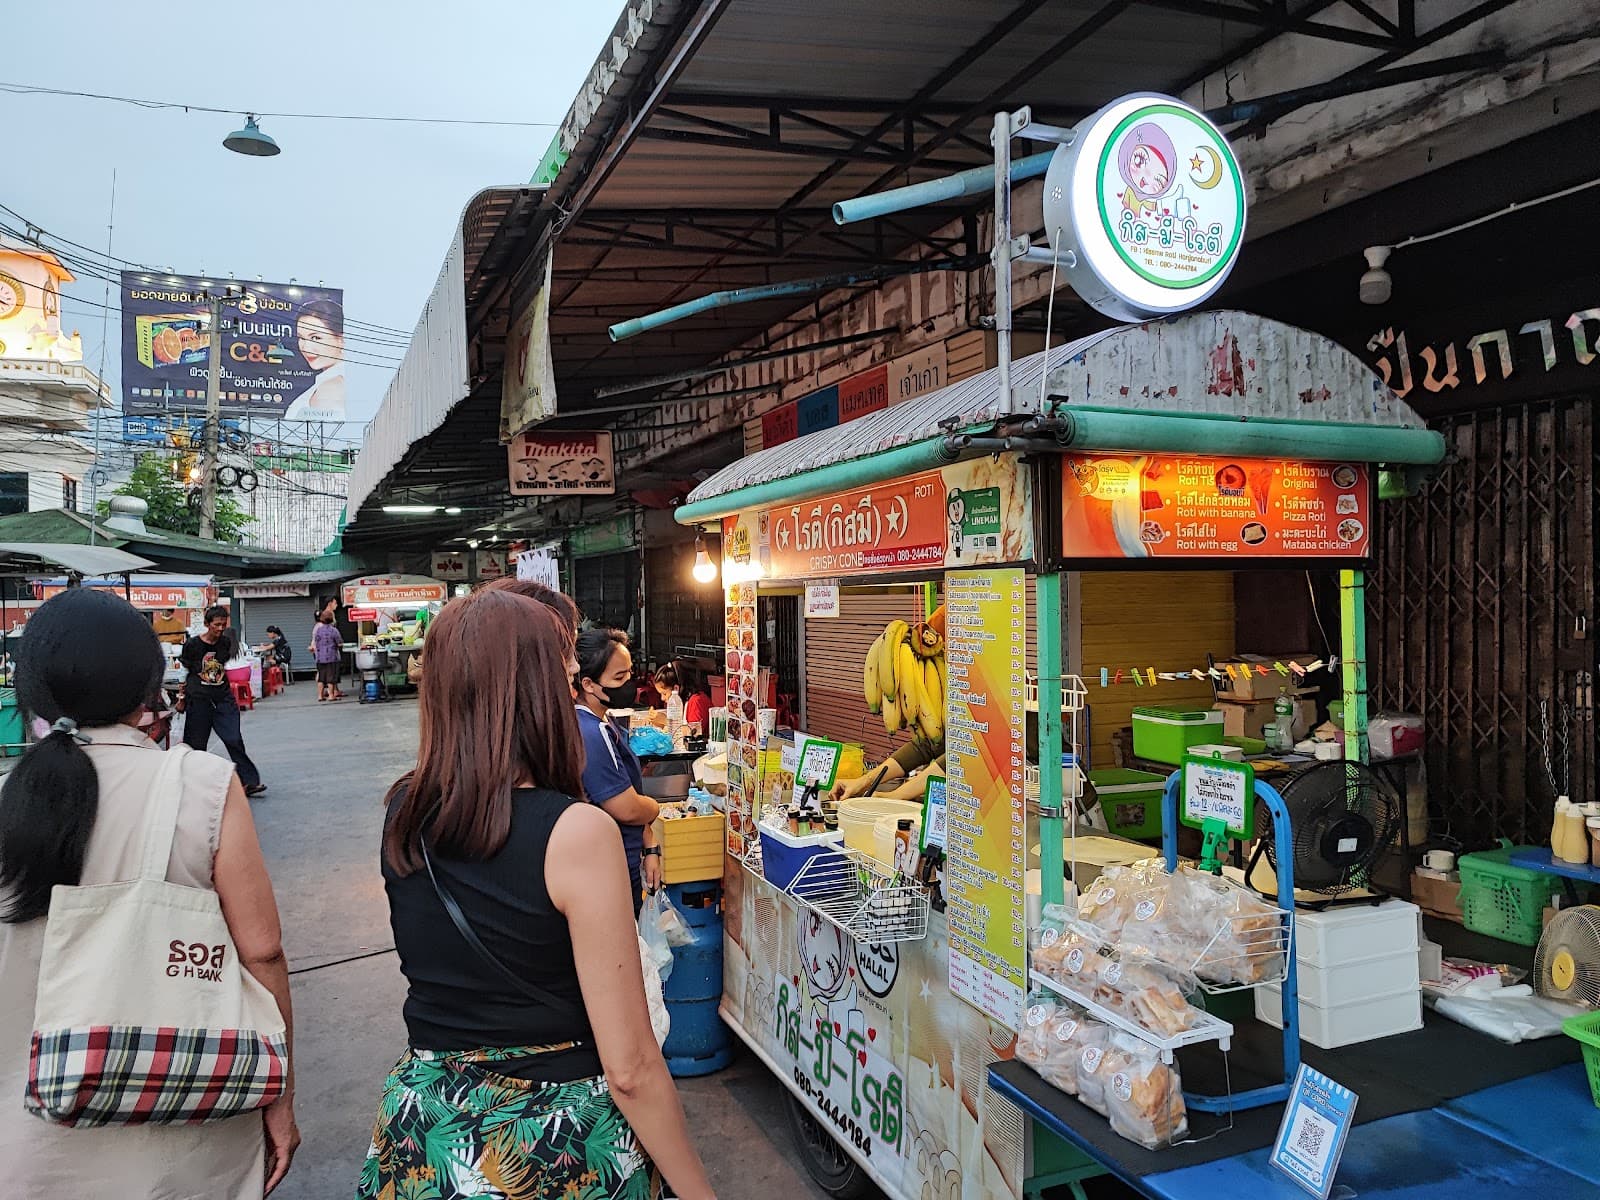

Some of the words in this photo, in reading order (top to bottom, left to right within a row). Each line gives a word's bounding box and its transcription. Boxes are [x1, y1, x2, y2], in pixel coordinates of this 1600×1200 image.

[900, 356, 940, 399] เจ้าเก่า
[1179, 475, 1198, 486] Roti
[1283, 478, 1318, 491] Original
[915, 483, 934, 499] ROTI
[1176, 507, 1196, 517] Roti
[1198, 508, 1219, 518] with
[1221, 508, 1256, 518] banana
[1283, 511, 1306, 522] Pizza
[1308, 511, 1326, 522] Roti
[1176, 540, 1196, 550] Roti
[1198, 540, 1219, 550] with
[1221, 541, 1238, 552] egg
[1282, 540, 1317, 550] Mataba
[1318, 540, 1352, 550] chicken
[810, 555, 837, 571] CRISPY
[839, 551, 864, 567] CONE
[897, 545, 942, 562] 080-2444784
[168, 939, 226, 969] ธอส
[197, 967, 223, 983] BANK
[859, 951, 889, 984] HALAL
[794, 1065, 873, 1158] 080-2444784
